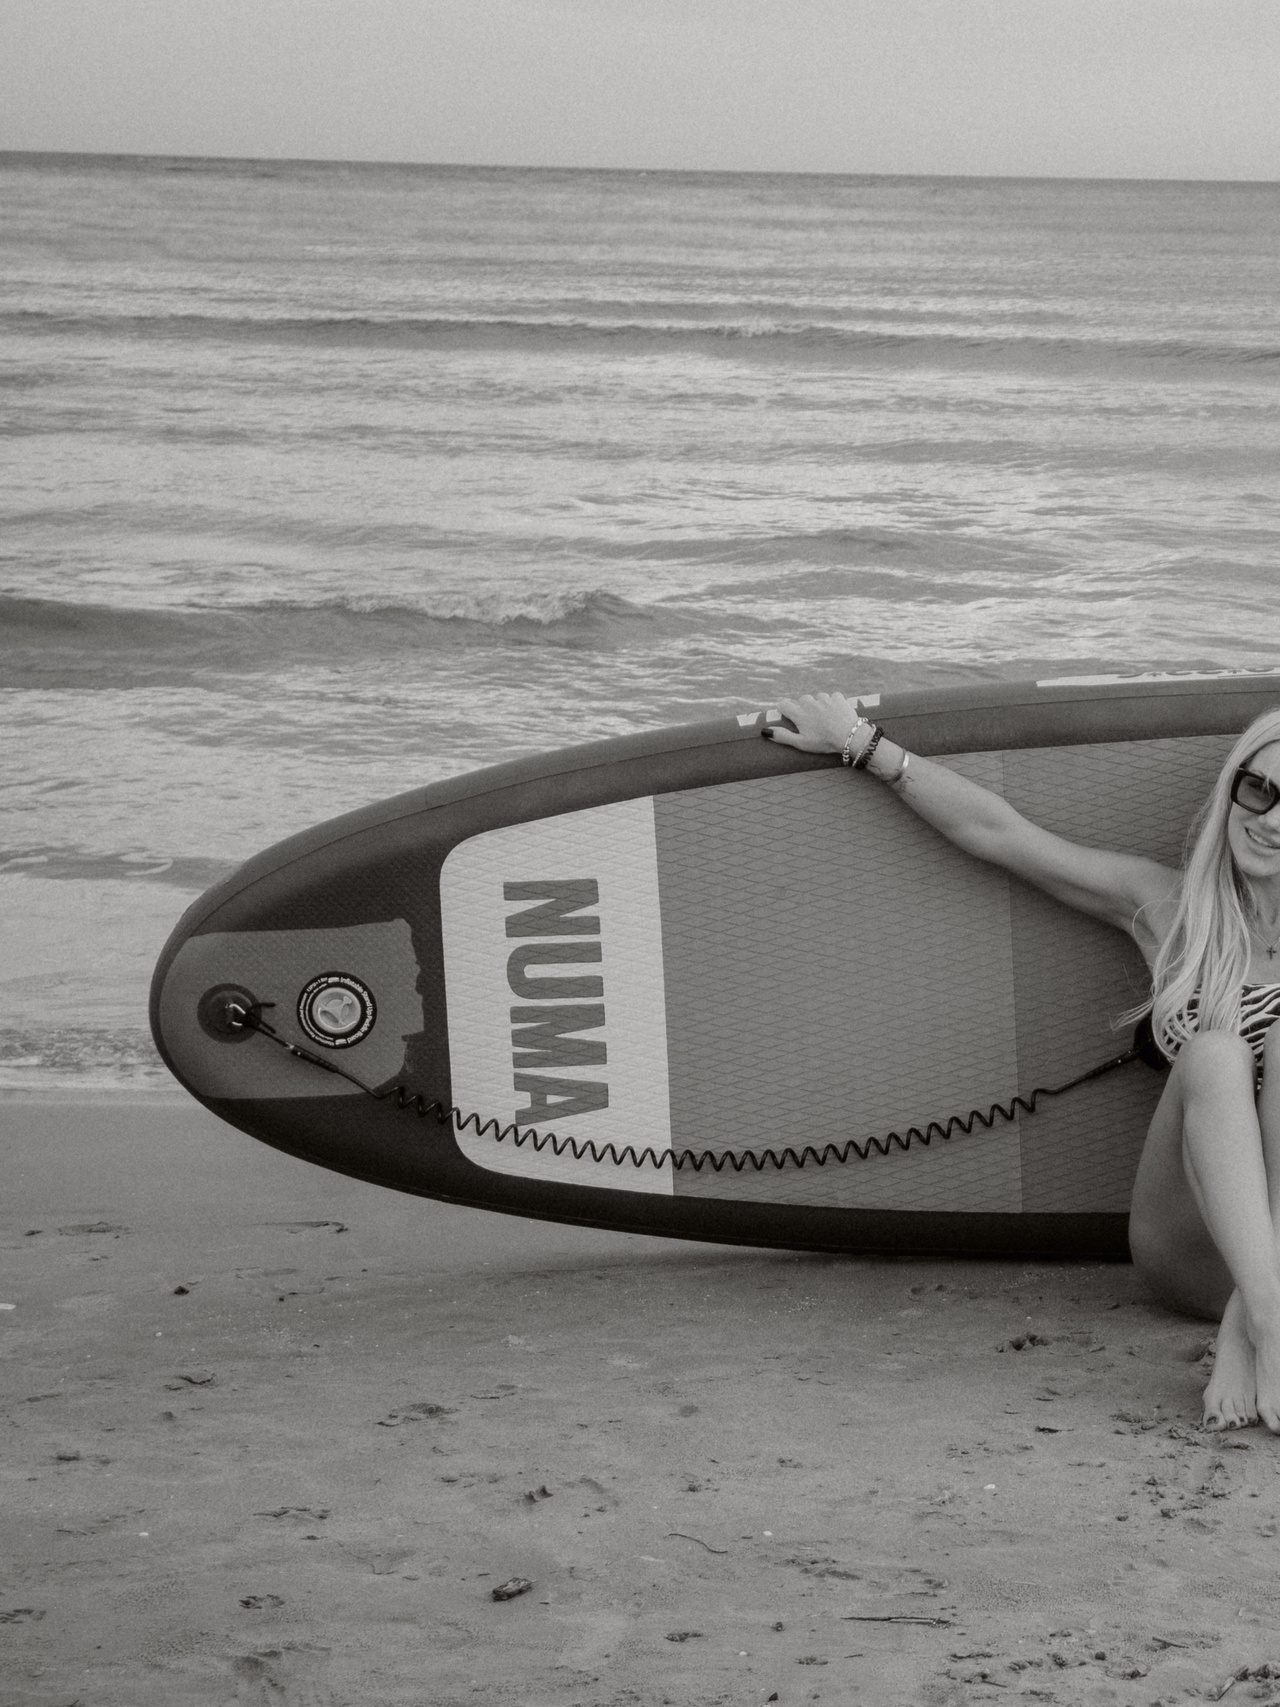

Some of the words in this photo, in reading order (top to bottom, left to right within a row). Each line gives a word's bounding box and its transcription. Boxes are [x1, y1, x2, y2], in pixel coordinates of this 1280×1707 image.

[361, 991, 373, 1007] Stand
[503, 878, 609, 1127] NUMA
[366, 1006, 373, 1015] Up
[361, 1015, 373, 1032] Paddle
[347, 1031, 363, 1043] Board
